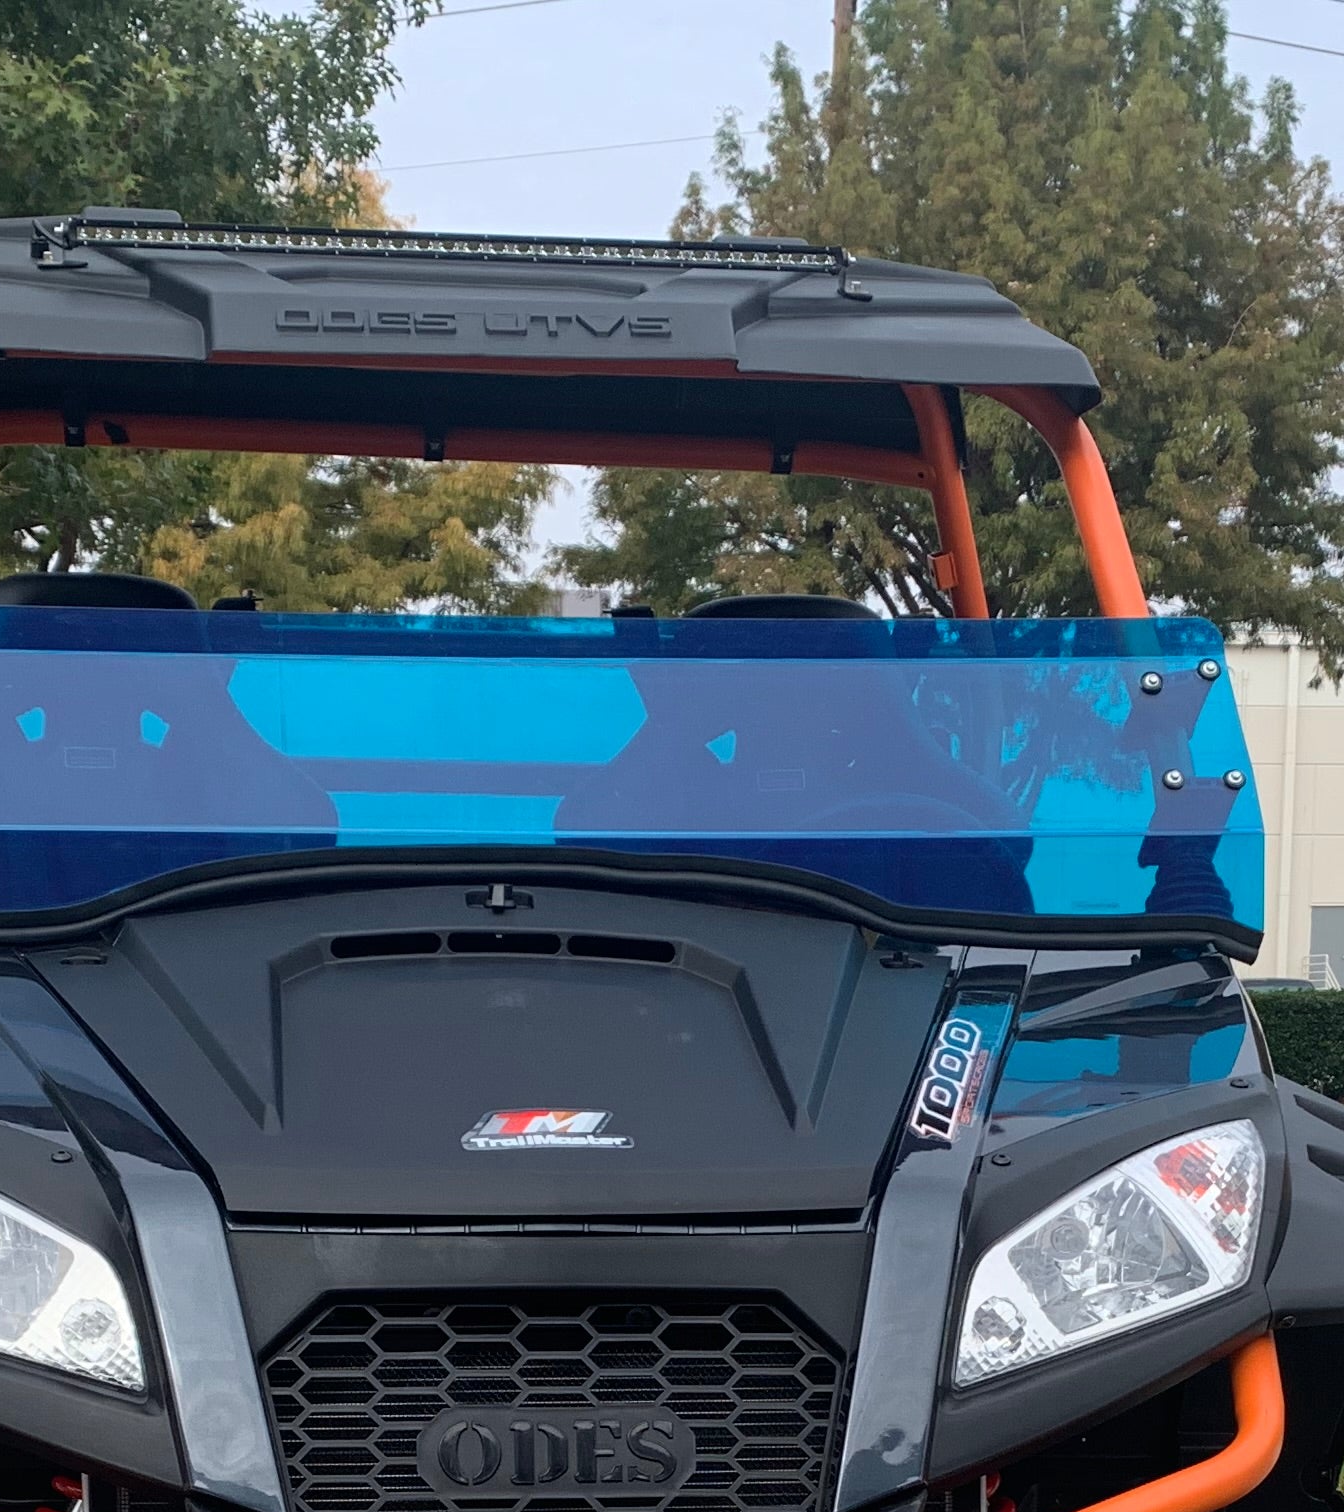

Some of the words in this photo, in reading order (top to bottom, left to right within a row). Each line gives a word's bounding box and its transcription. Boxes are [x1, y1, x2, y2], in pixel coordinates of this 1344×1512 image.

[483, 311, 673, 338] UTVS
[910, 1017, 983, 1140] 1000
[470, 1134, 627, 1148] TrailMaster
[437, 1419, 678, 1486] ODES
